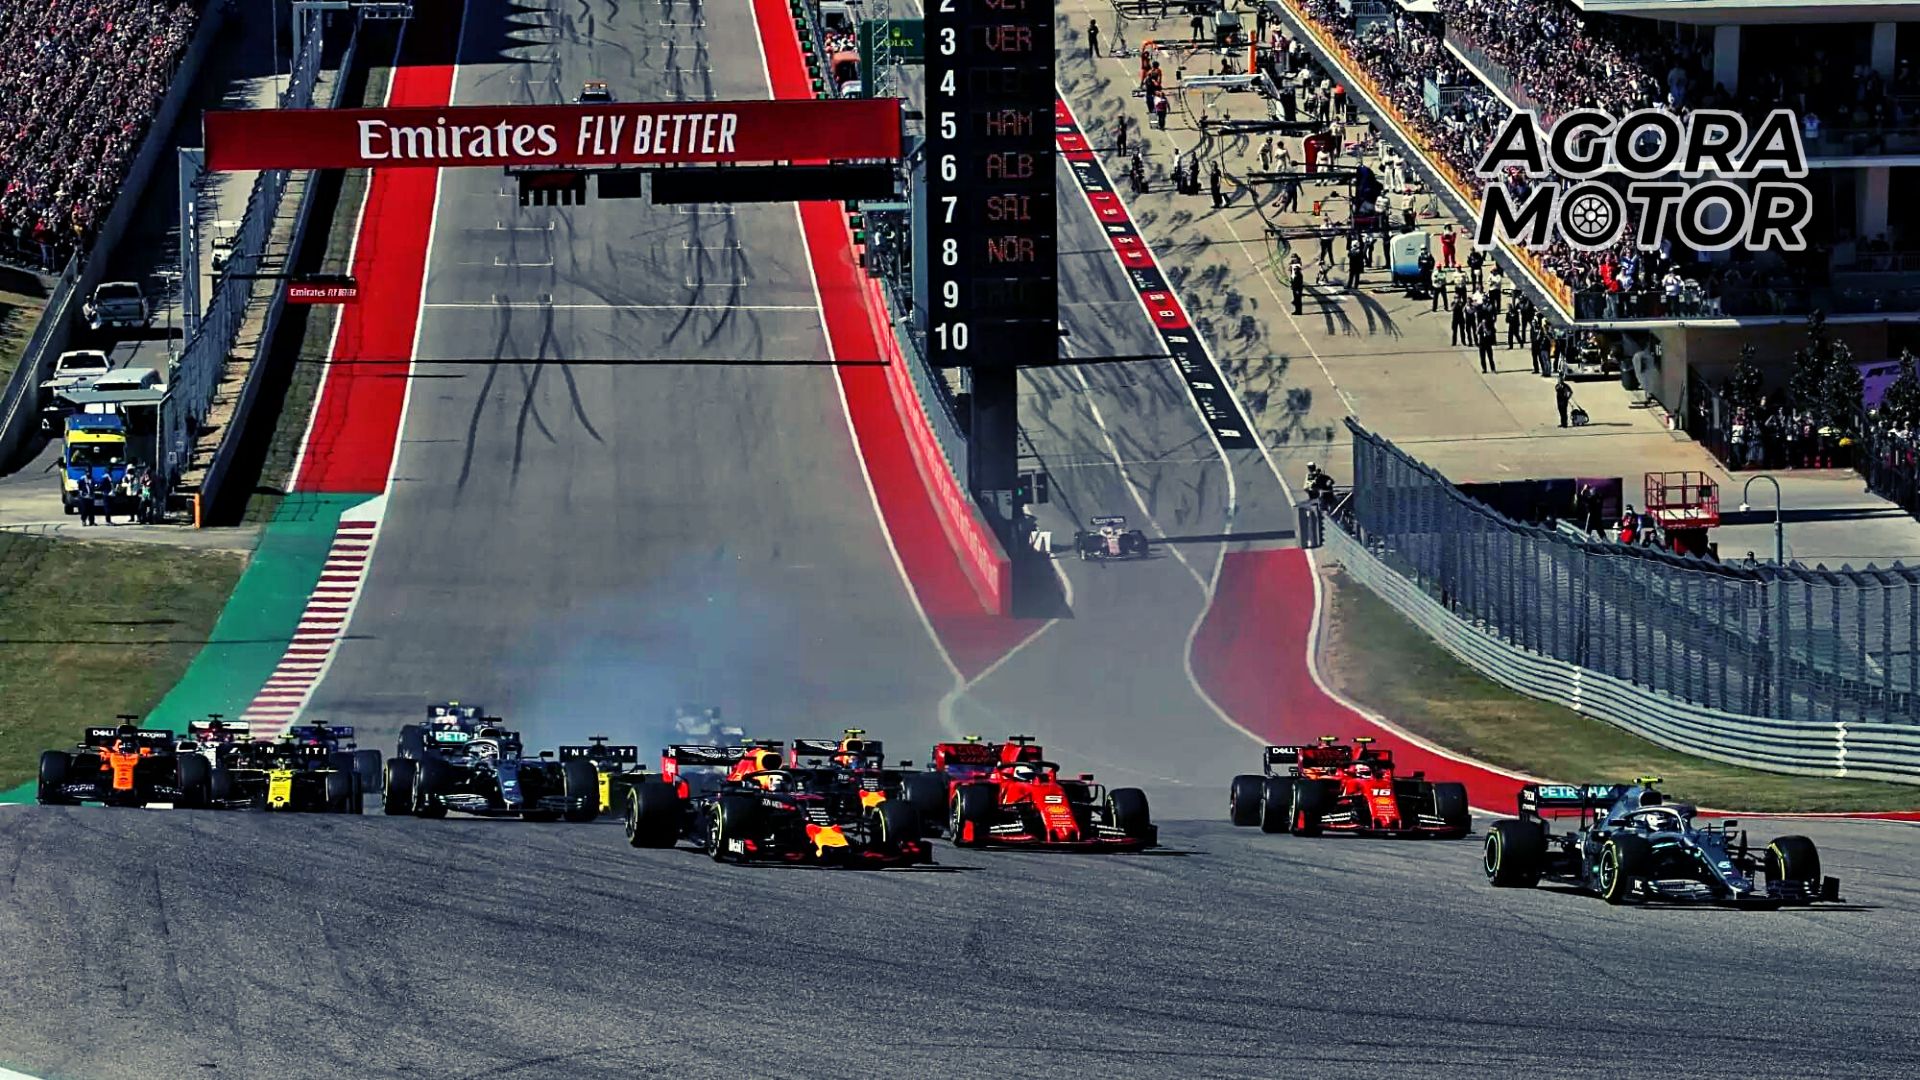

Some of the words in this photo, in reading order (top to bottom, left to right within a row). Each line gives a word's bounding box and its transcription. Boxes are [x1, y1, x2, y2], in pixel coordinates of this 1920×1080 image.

[940, 28, 956, 56] 3
[985, 27, 1033, 51] VER
[940, 70, 956, 97] 4
[356, 116, 558, 160] Emirates
[577, 115, 625, 155] FLY
[633, 113, 738, 154] BETTER
[940, 112, 957, 140] 5
[986, 111, 1034, 136] HAM
[941, 154, 957, 182] 6
[986, 153, 1034, 179] ALB
[941, 196, 958, 224] 7
[987, 195, 1032, 221] SAI
[942, 238, 958, 266] 8
[988, 238, 1035, 263] NOR
[290, 288, 326, 297] Emirates
[943, 280, 959, 308] 9
[935, 322, 969, 351] 10
[1043, 795, 1063, 804] 5
[1370, 788, 1391, 796] 16
